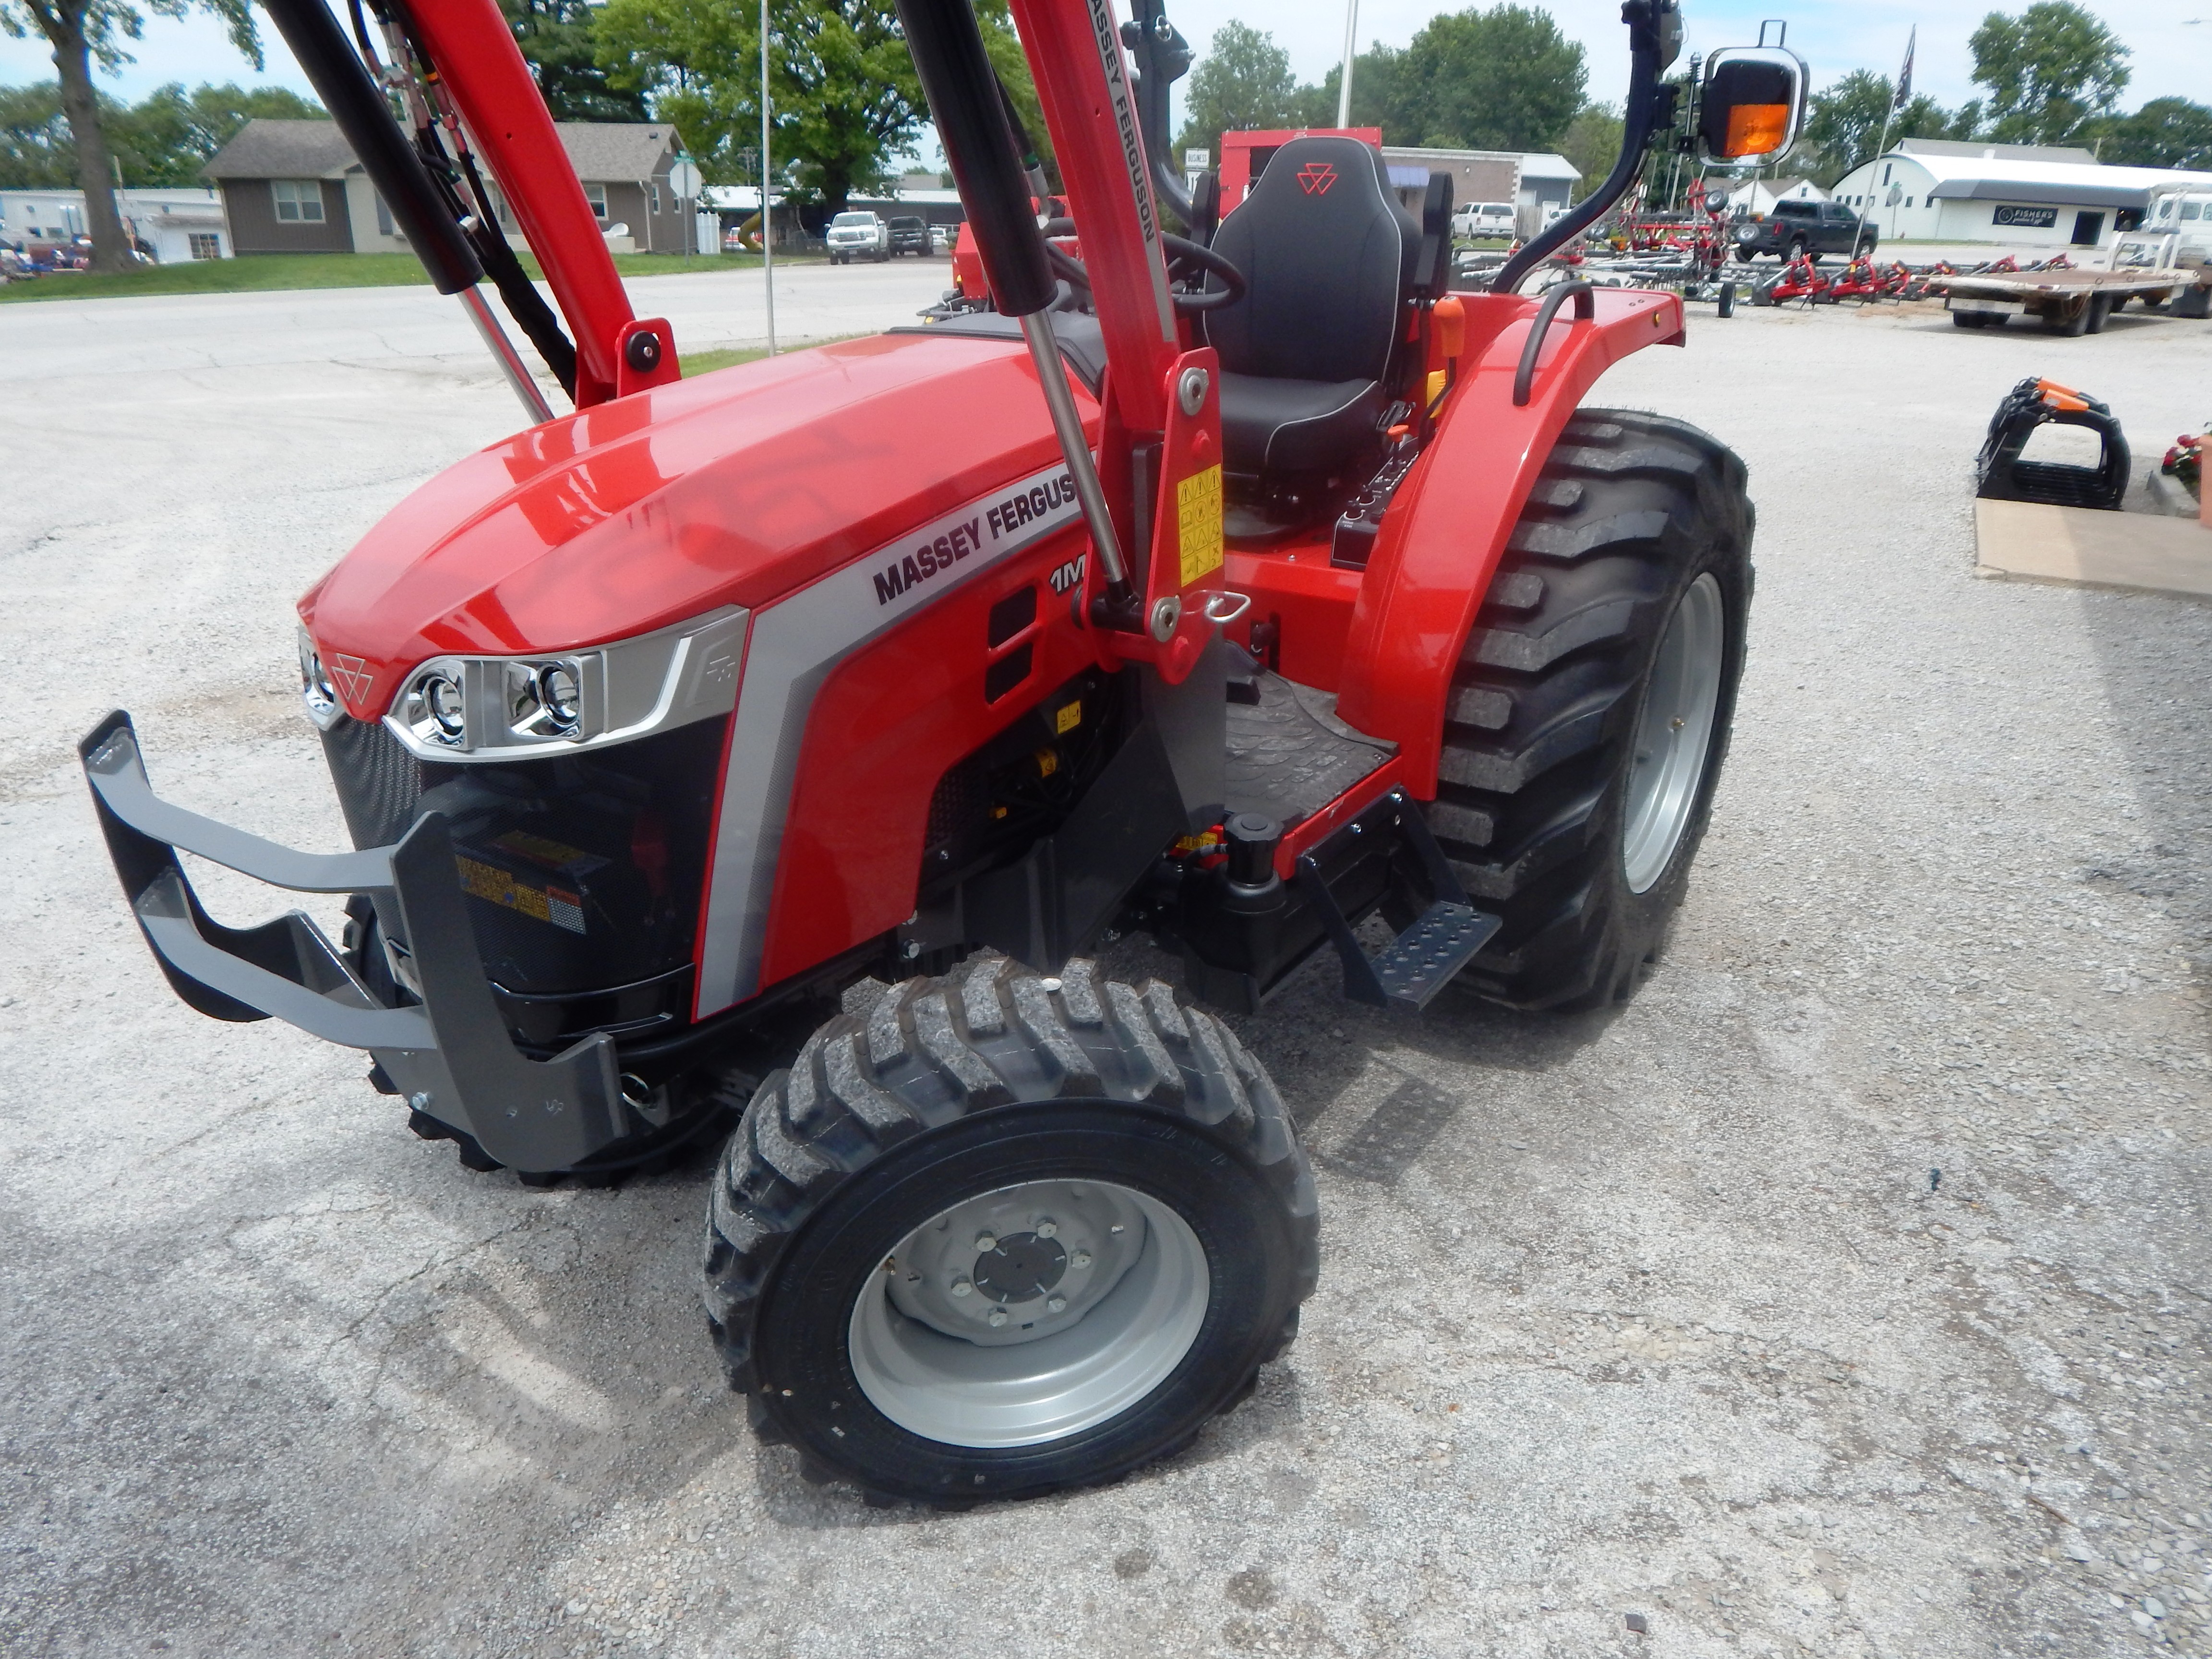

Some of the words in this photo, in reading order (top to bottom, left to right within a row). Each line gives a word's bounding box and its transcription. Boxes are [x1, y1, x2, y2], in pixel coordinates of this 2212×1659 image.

[1116, 95, 1154, 243] FERGUSON
[1188, 153, 1207, 163] BUSINESS
[873, 517, 981, 606] MASSEY
